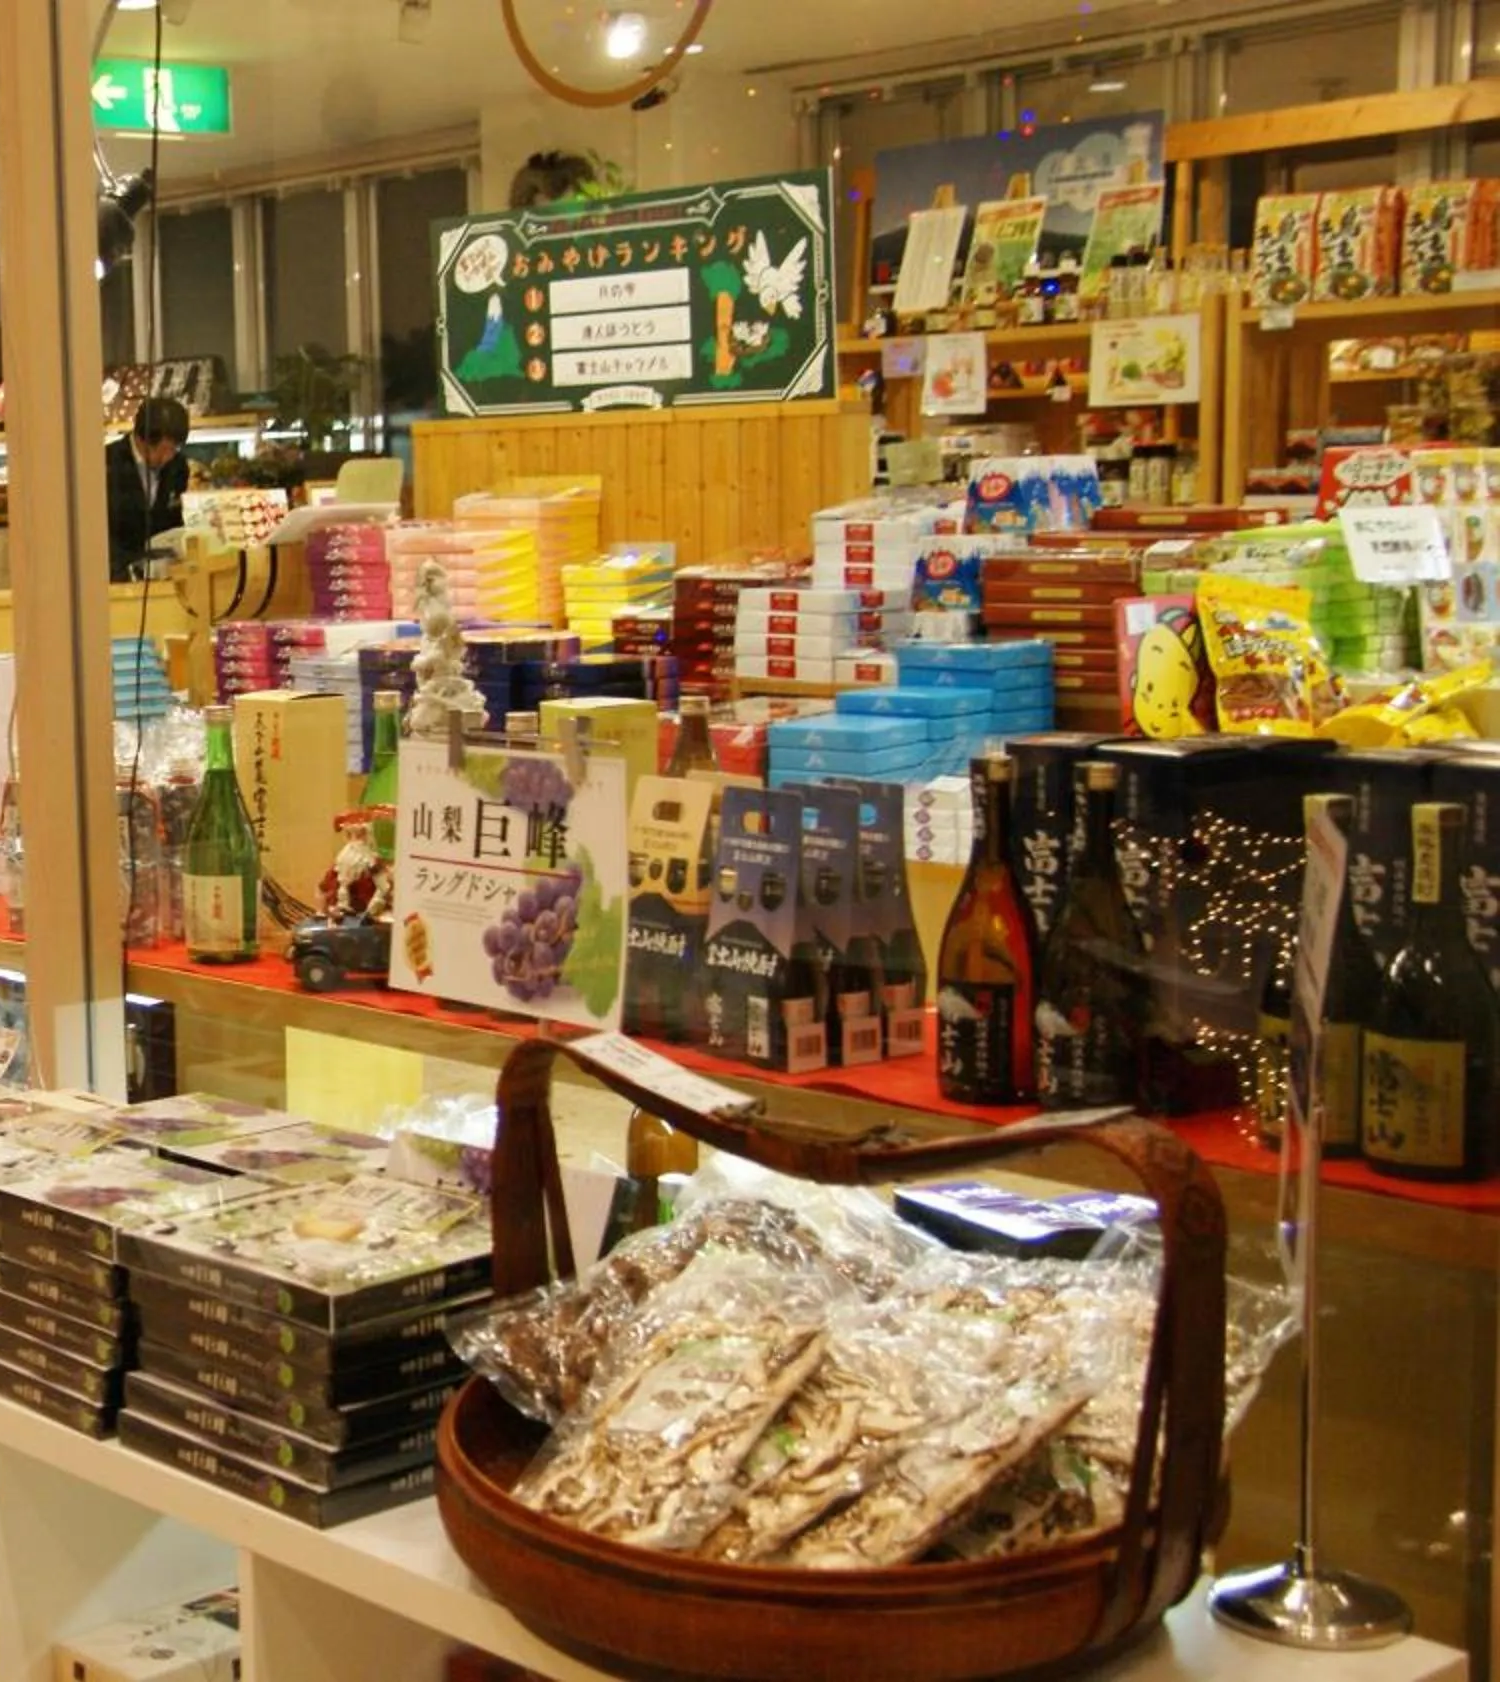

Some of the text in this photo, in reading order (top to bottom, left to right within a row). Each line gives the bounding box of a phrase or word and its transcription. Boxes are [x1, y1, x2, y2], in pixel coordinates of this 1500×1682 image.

[414, 867, 517, 905] ラングドシャ
